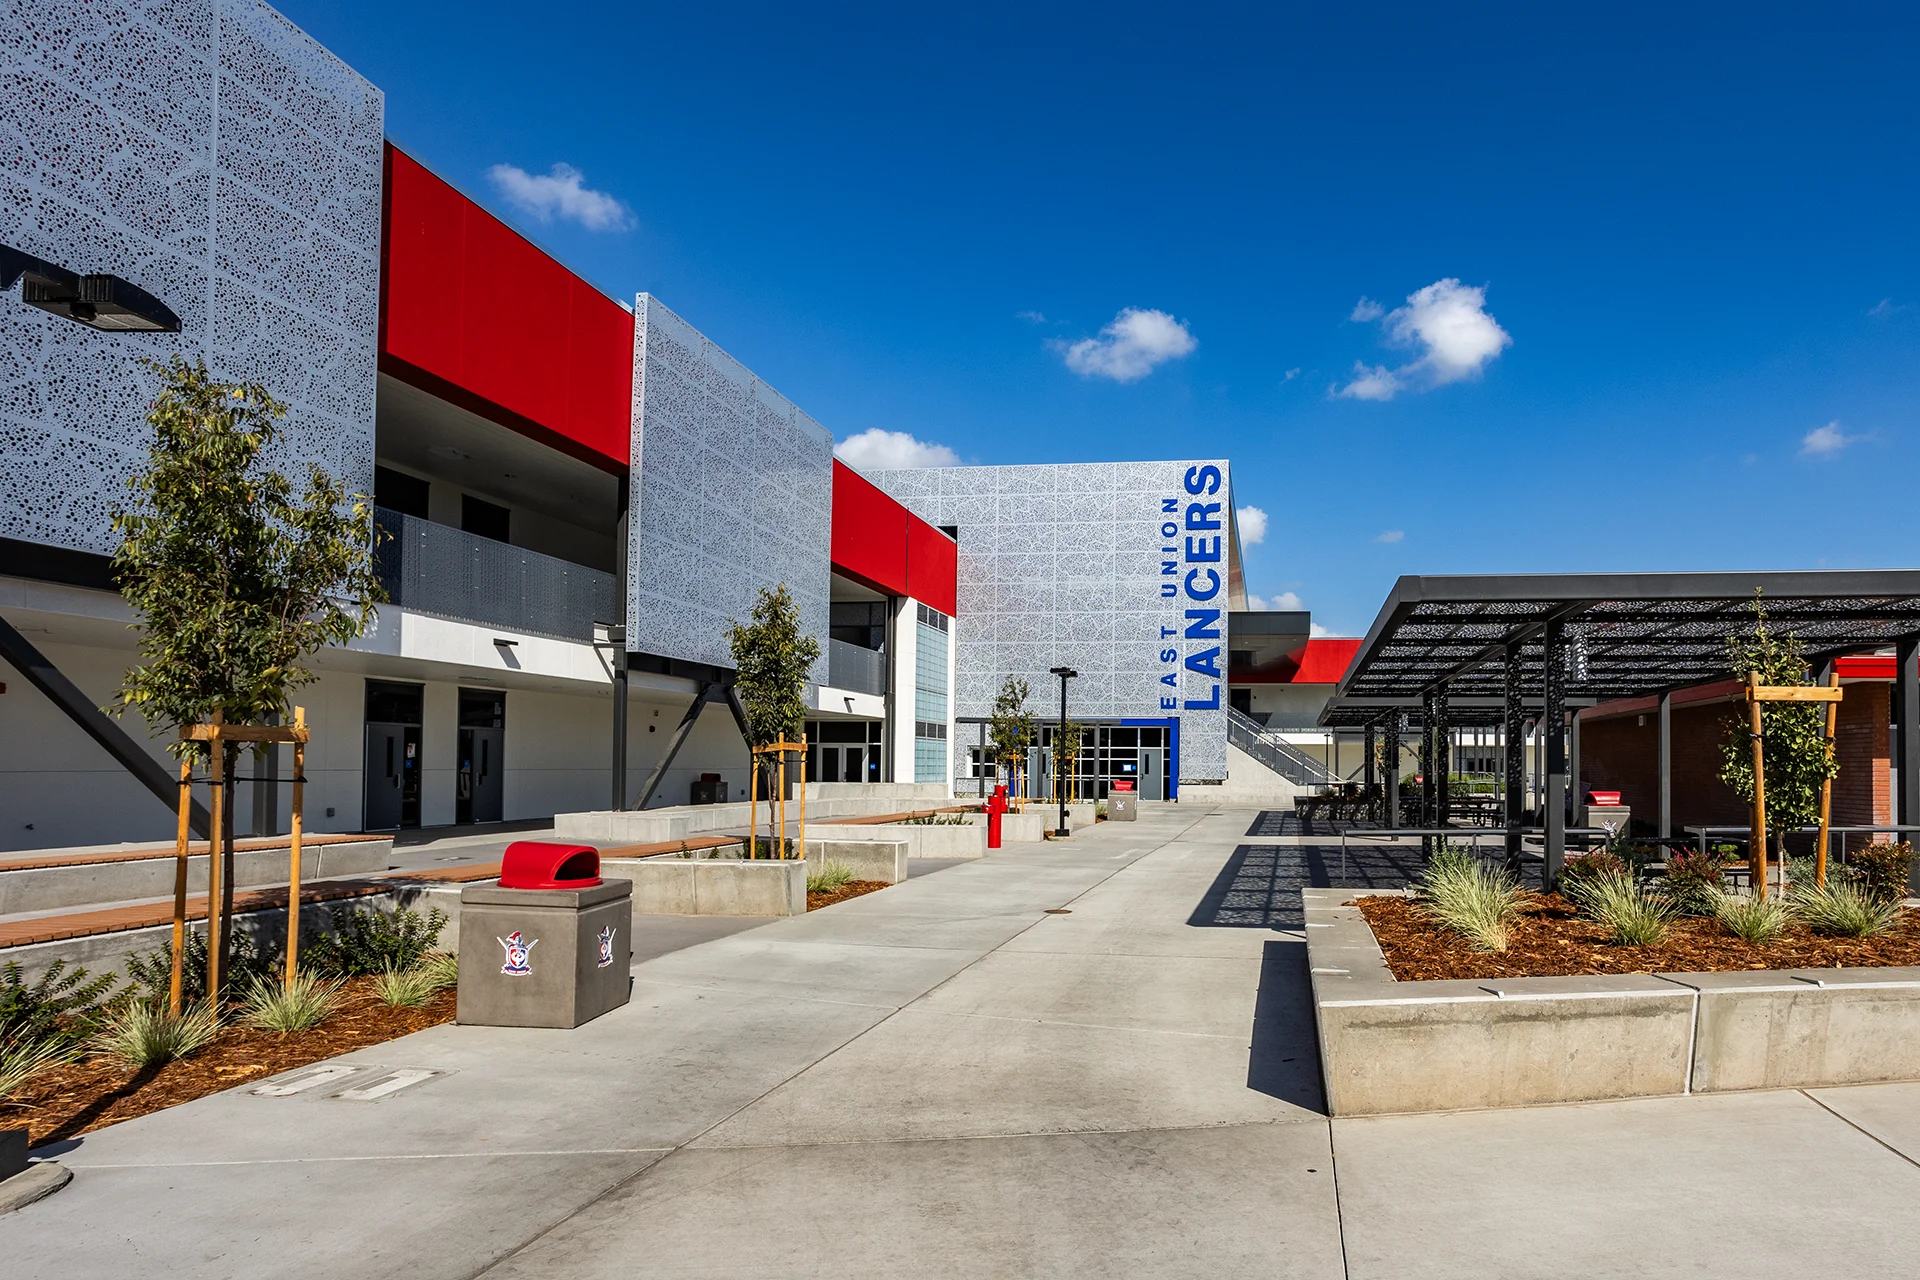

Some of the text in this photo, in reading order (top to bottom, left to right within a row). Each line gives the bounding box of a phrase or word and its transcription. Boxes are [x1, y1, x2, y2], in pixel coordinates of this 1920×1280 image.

[1160, 498, 1179, 710] EAST UNION
[1184, 465, 1222, 710] LANCERS
